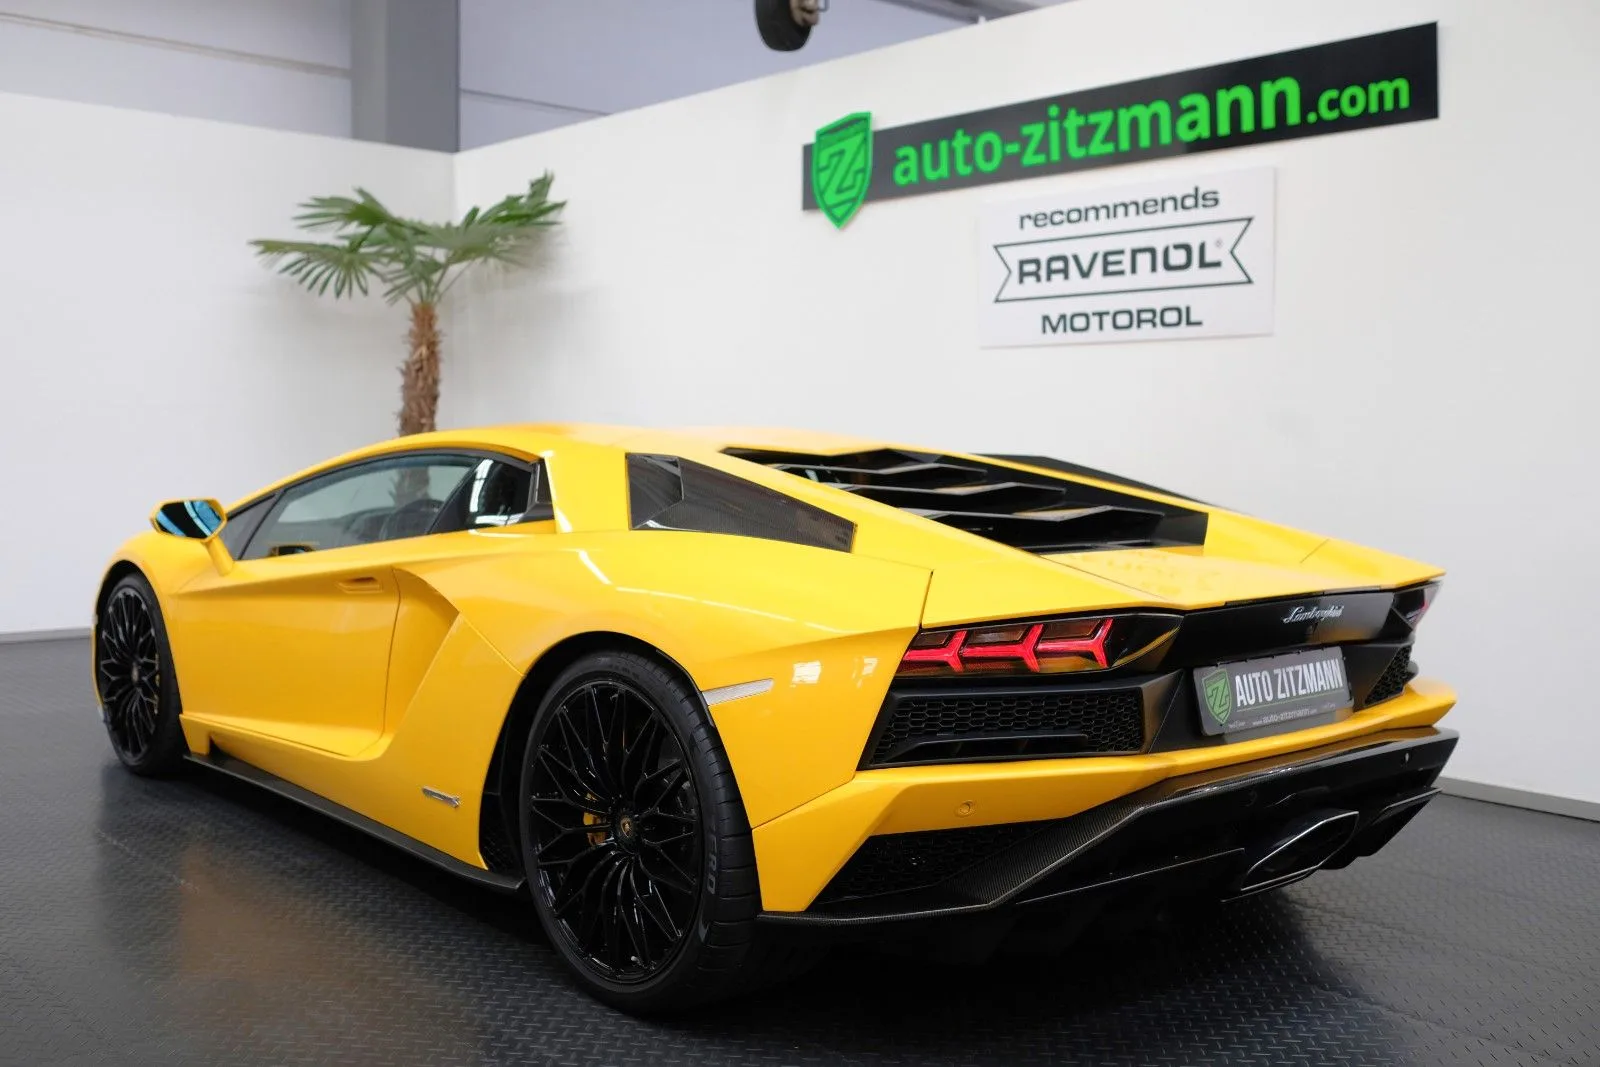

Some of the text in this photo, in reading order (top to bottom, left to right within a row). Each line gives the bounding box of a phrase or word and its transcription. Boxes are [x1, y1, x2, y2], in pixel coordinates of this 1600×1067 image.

[893, 76, 1411, 185] auto-zitzmann.com
[1018, 186, 1220, 230] recommends
[1041, 305, 1203, 335] MOTOROL
[1235, 658, 1343, 707] AUTO ZITZMANN
